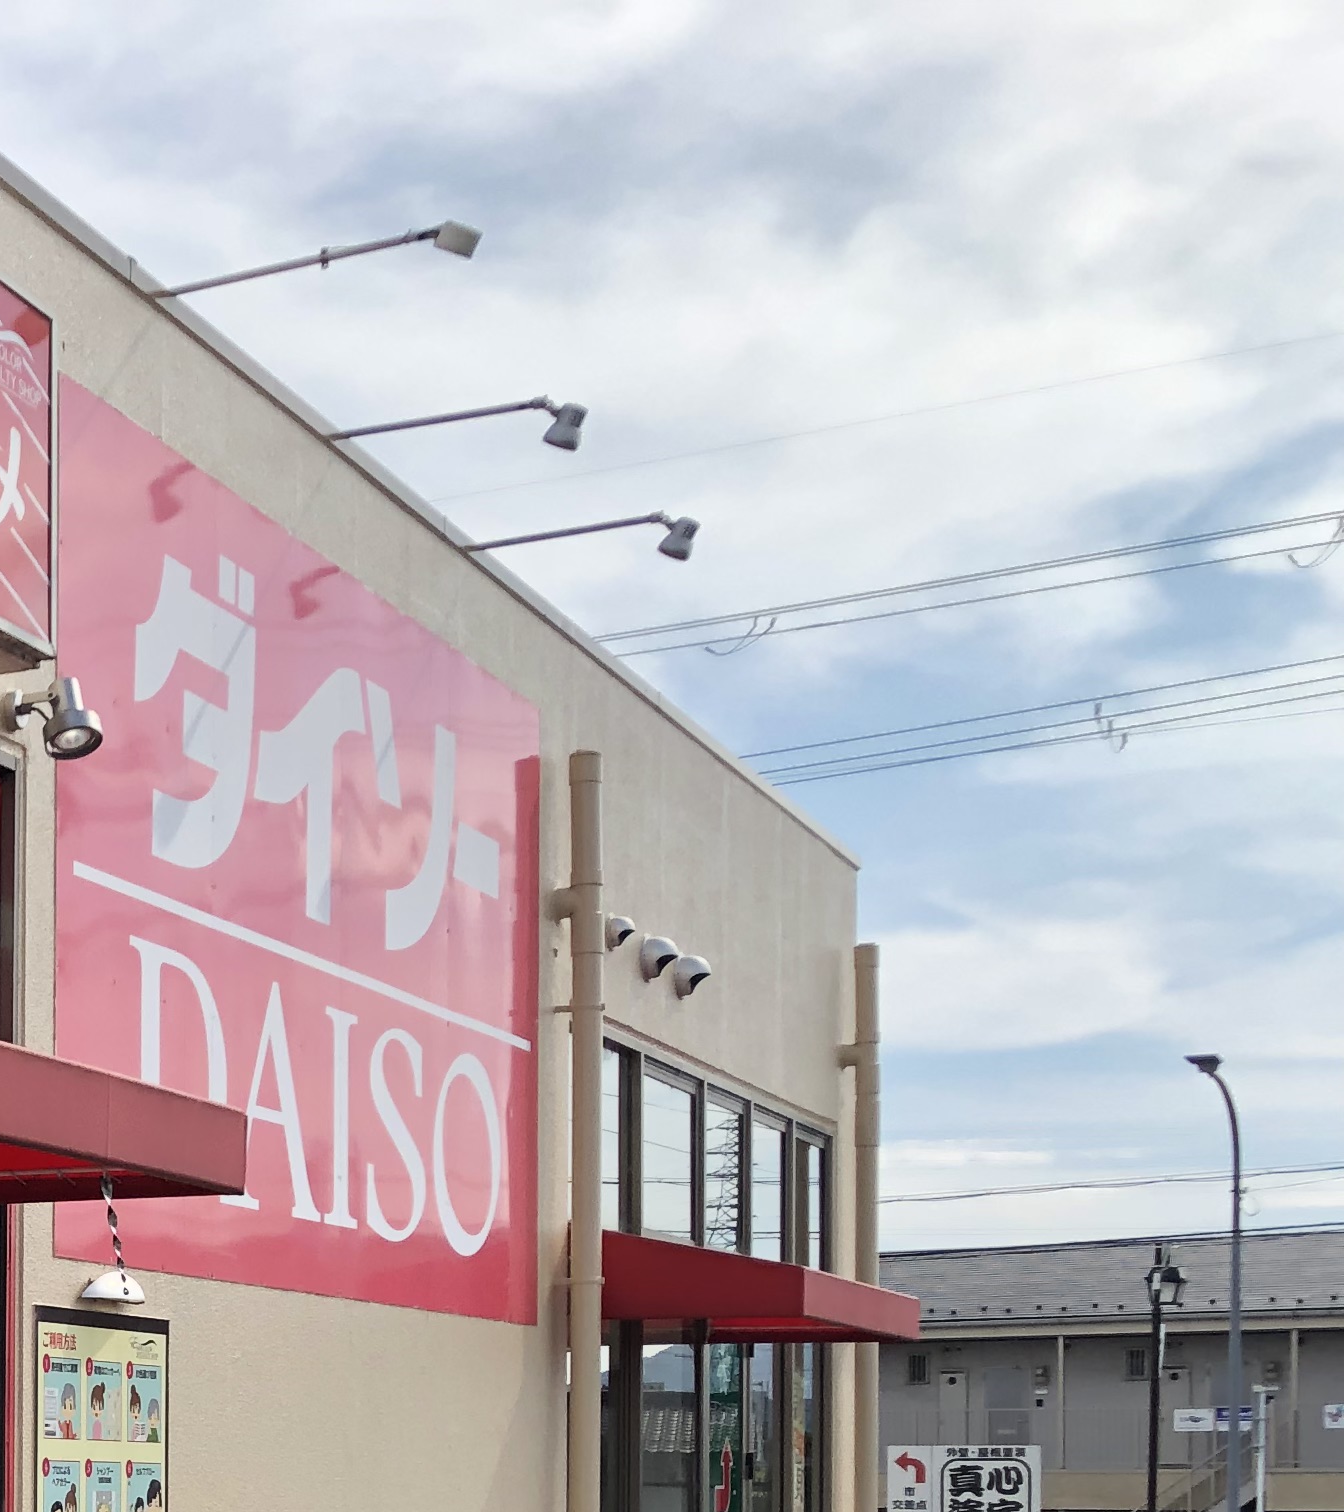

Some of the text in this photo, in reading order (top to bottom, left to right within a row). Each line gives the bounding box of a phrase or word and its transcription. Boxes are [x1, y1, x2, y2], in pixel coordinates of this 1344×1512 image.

[18, 378, 42, 405] SHOP
[133, 553, 500, 951] ダイソー
[129, 933, 500, 1257] DAISO
[42, 1331, 77, 1351] ご利用方法
[949, 1465, 1024, 1497] 真心
